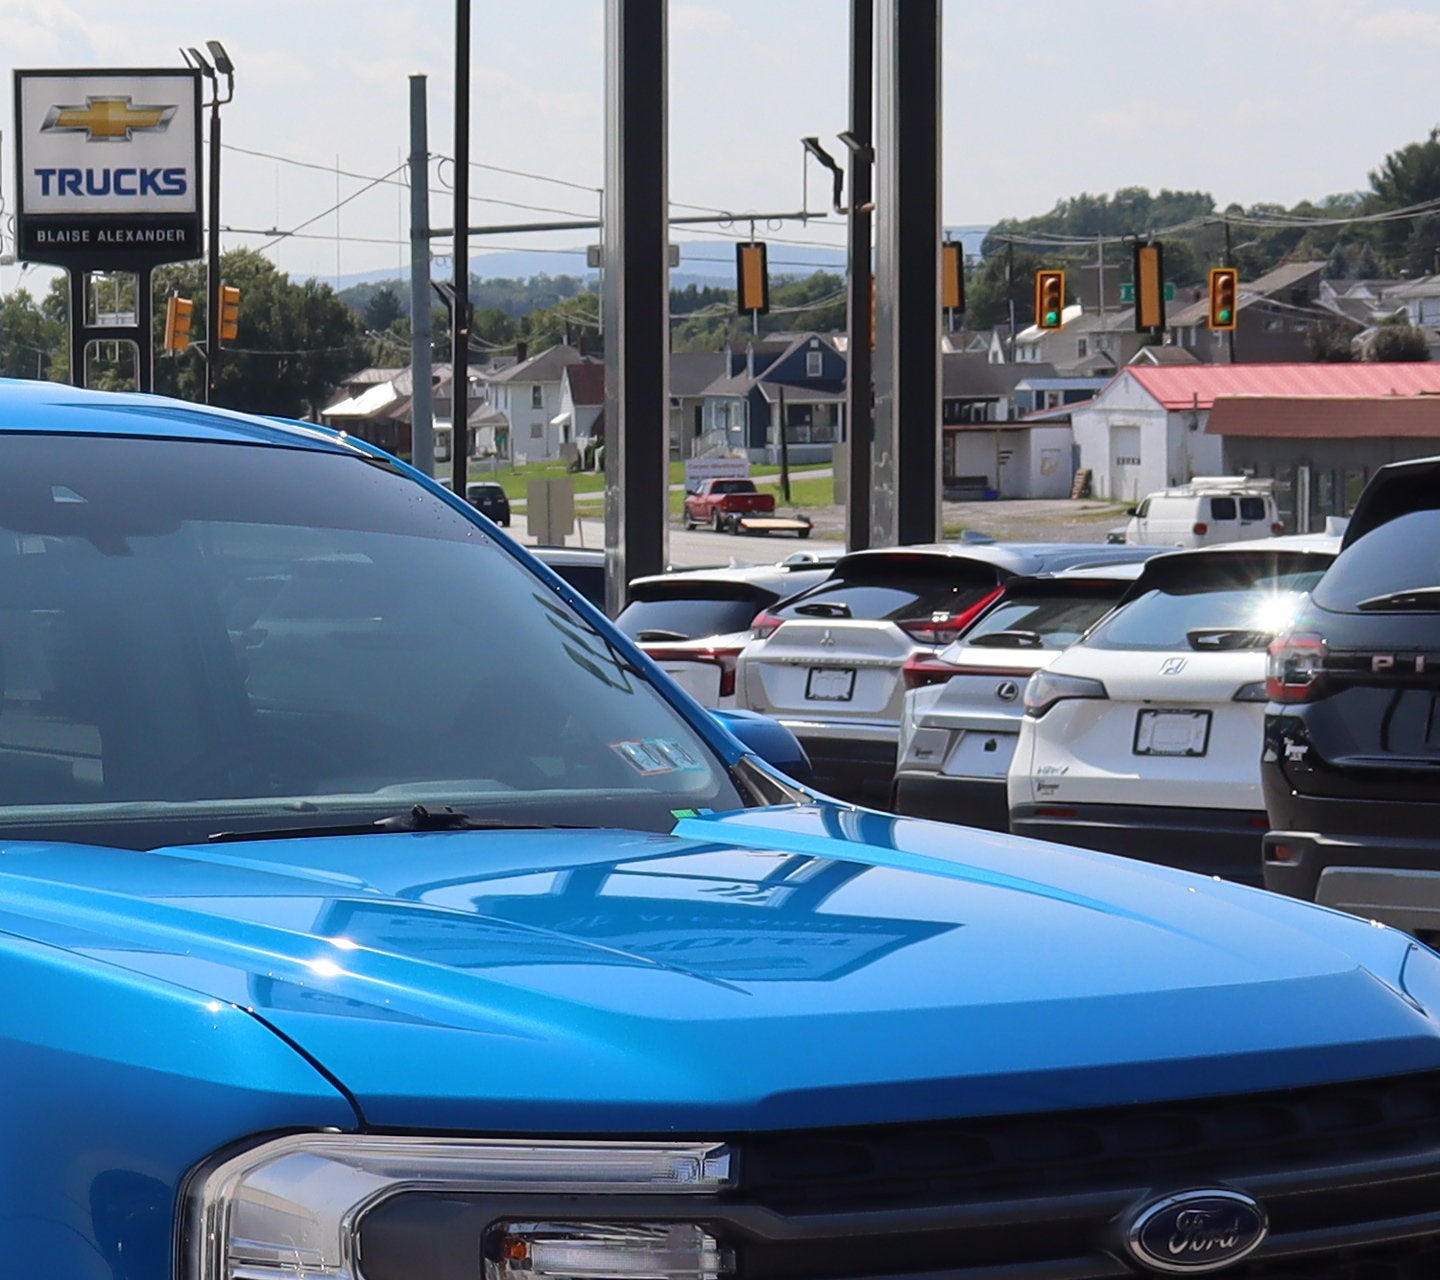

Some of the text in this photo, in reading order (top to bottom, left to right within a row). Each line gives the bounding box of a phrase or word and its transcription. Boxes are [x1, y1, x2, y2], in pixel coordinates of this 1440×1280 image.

[34, 167, 187, 197] TRUCKS
[36, 229, 186, 244] BLAISE ALEXANDER
[1168, 1209, 1240, 1255] Ford
